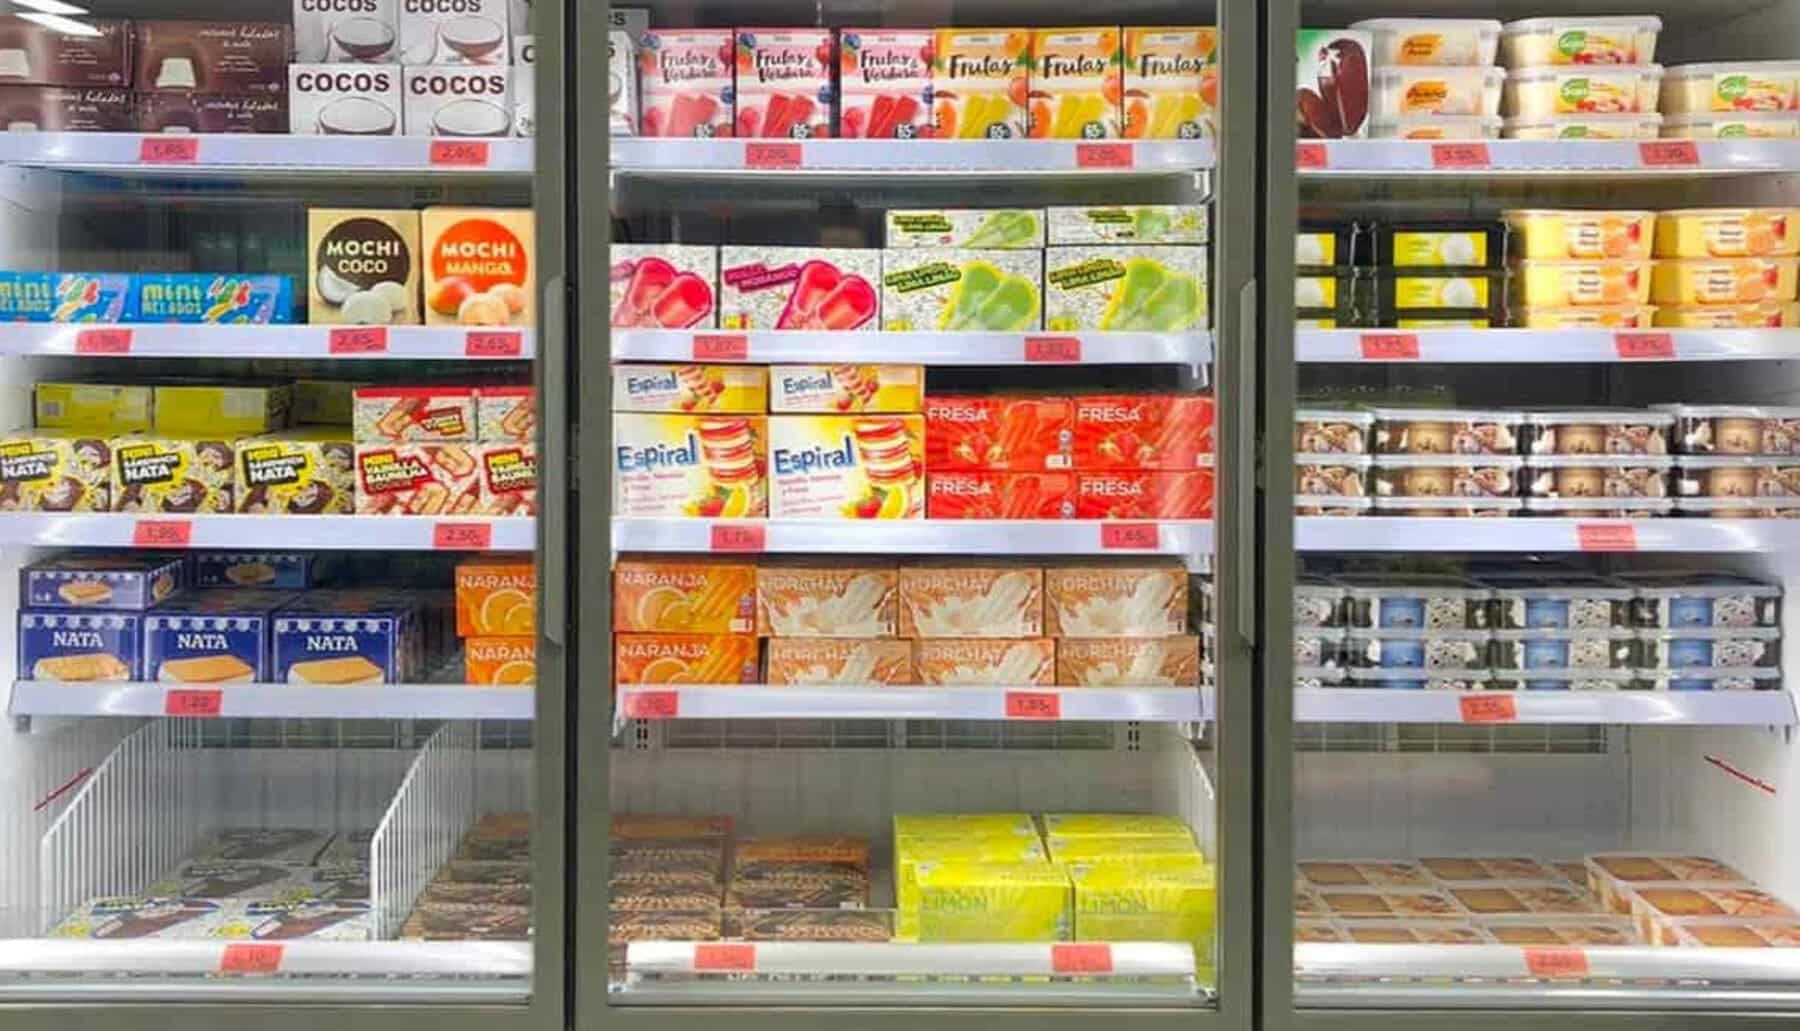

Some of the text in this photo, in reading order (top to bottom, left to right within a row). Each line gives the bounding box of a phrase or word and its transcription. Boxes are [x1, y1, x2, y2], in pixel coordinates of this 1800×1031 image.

[756, 49, 806, 70] Frutas
[860, 49, 909, 70] Frutas
[949, 54, 1014, 79] Frutas
[1043, 54, 1107, 79] Frutas
[1141, 54, 1205, 79] Frutas
[296, 73, 390, 92] COCOS
[410, 75, 505, 95] COCOS
[326, 240, 399, 257] MOCHI
[441, 242, 515, 258] MOCHI
[337, 259, 388, 274] COCO
[446, 261, 512, 275] MANGO
[142, 276, 202, 301] mini
[627, 370, 677, 393] Espiral
[783, 372, 833, 394] Espiral
[928, 406, 988, 421] FRESA
[1078, 407, 1140, 421] FRESA
[617, 433, 698, 471] Espiral
[774, 436, 856, 475] Espiral
[250, 465, 297, 483] NATA
[931, 480, 991, 495] FRESA
[1080, 480, 1142, 495] FRESA
[619, 572, 708, 586] NARANJA
[53, 631, 104, 648] NATA
[177, 633, 228, 650] NATA
[306, 636, 359, 652] NATA
[620, 643, 710, 657] NARANJA
